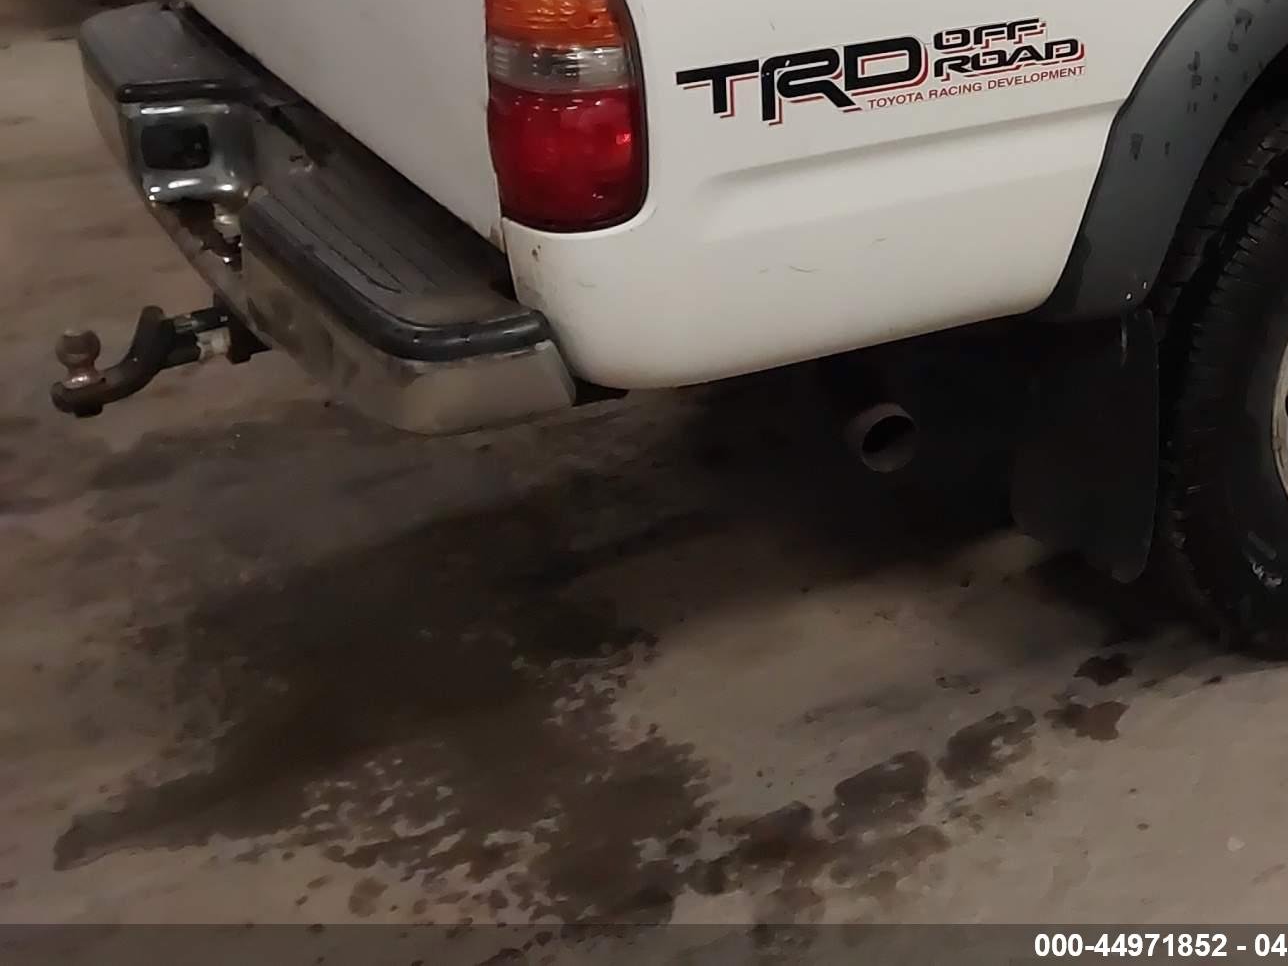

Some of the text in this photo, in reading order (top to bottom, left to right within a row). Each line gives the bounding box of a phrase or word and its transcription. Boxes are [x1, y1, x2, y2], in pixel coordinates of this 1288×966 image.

[933, 18, 1046, 54] OFF
[676, 36, 930, 124] TRD
[934, 39, 1085, 82] ROAD
[867, 65, 1085, 110] TOYOTA RACING DEVELOPMENT
